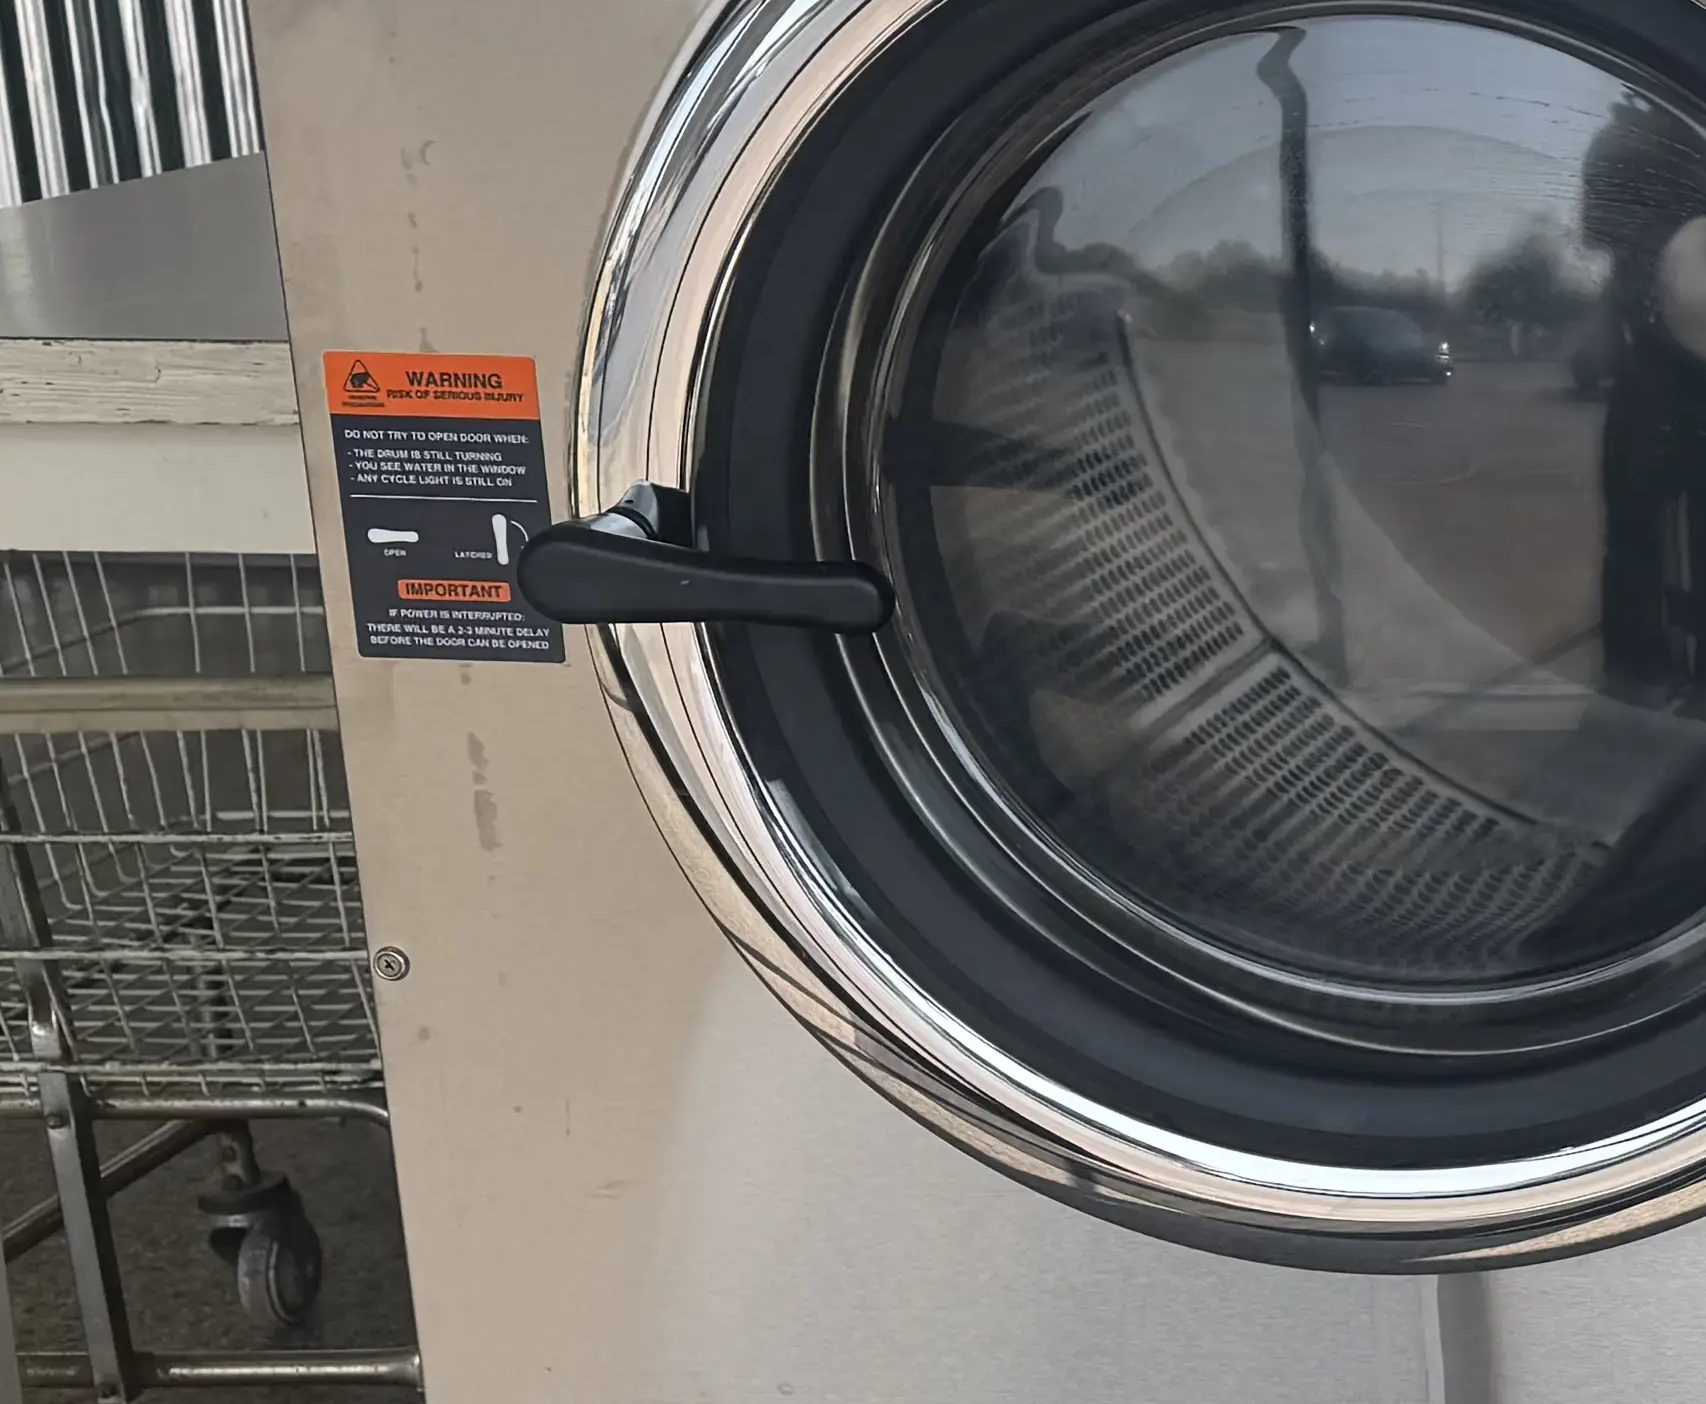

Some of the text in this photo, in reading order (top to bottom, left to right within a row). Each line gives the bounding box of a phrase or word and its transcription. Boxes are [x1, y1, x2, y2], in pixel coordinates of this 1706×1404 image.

[405, 371, 502, 389] WARNING
[387, 389, 524, 403] RISK OF SERIOUS INJURY
[345, 429, 360, 439] DO
[363, 430, 384, 440] NOT
[388, 431, 408, 440] TRY
[411, 431, 425, 441] TO
[428, 431, 457, 442] OPEN
[460, 432, 491, 443] DOOR
[354, 449, 502, 462] THE DRUM IS STILL TURNING
[355, 461, 526, 475] YOU SEE WATER IN THE WINDOW
[357, 474, 512, 487] ANY CYCLE LIGHT IS STILL ON
[455, 551, 492, 559] LATCHED
[405, 582, 502, 598] IMPORTANT
[389, 608, 397, 617] IF
[401, 609, 438, 618] POWER
[440, 610, 449, 618] IS
[367, 623, 401, 633] THERE
[404, 624, 428, 634] WILL
[432, 625, 444, 634] BE
[448, 625, 455, 634] A
[475, 626, 514, 636] MINUTE
[516, 628, 550, 637] DELAY
[370, 635, 549, 650] BEFORE THE DOOR CAN BE OPENED
